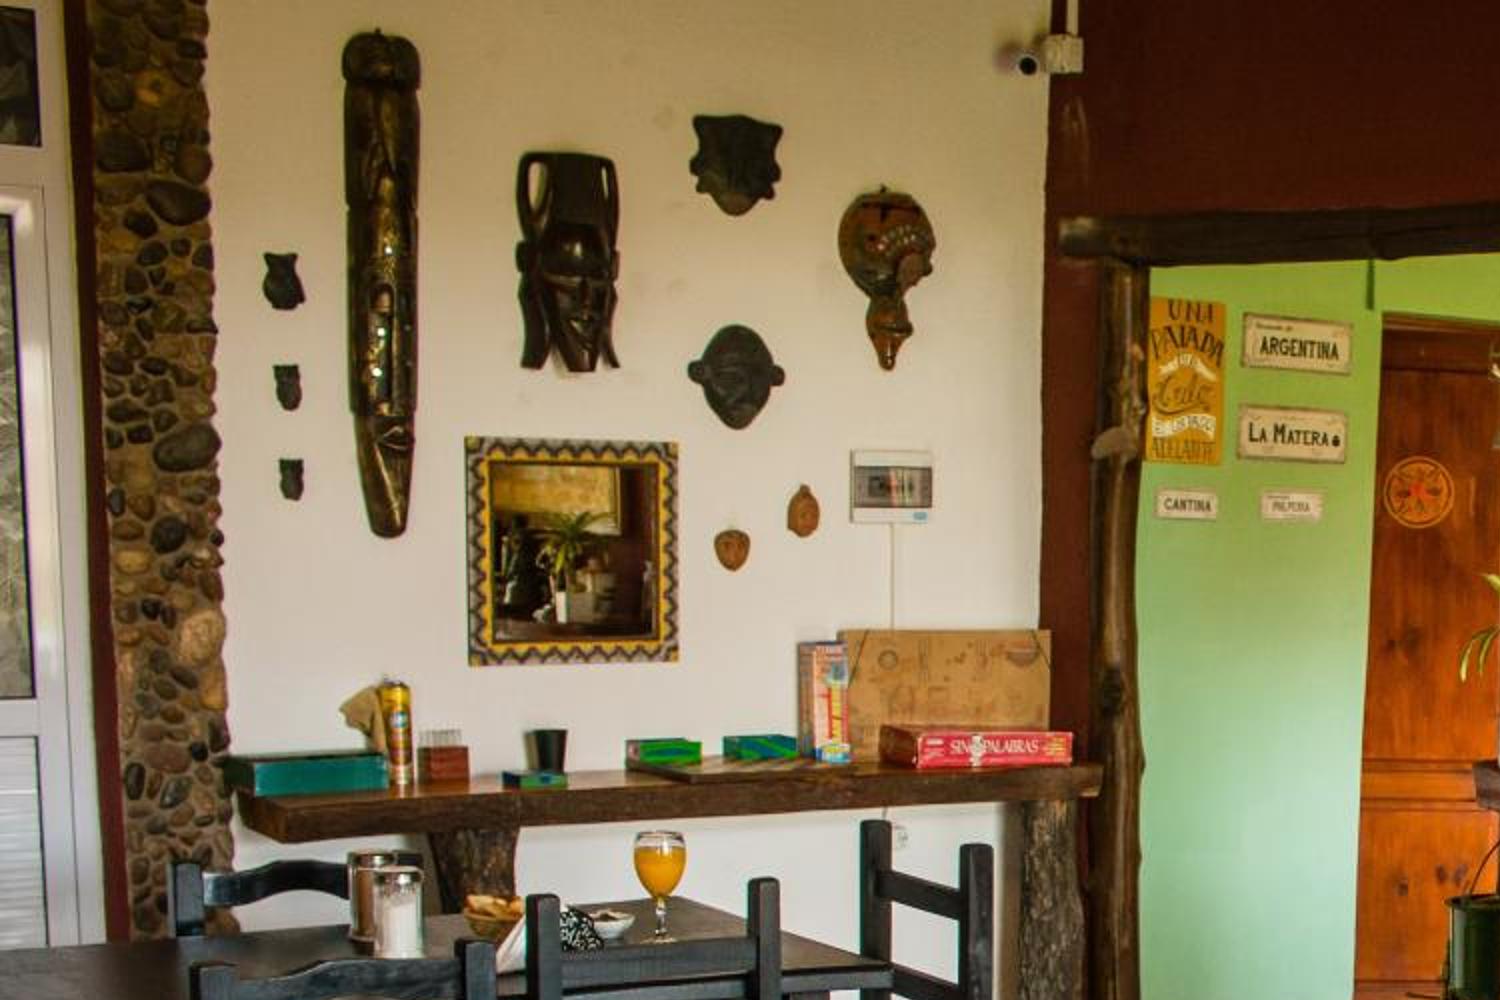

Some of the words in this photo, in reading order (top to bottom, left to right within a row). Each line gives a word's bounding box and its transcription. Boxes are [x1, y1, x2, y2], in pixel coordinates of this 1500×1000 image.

[1260, 336, 1339, 360] ARGENTINA
[1163, 496, 1212, 513] CANTINA
[950, 738, 969, 754] SIN
[982, 738, 1039, 754] PALABRAS
